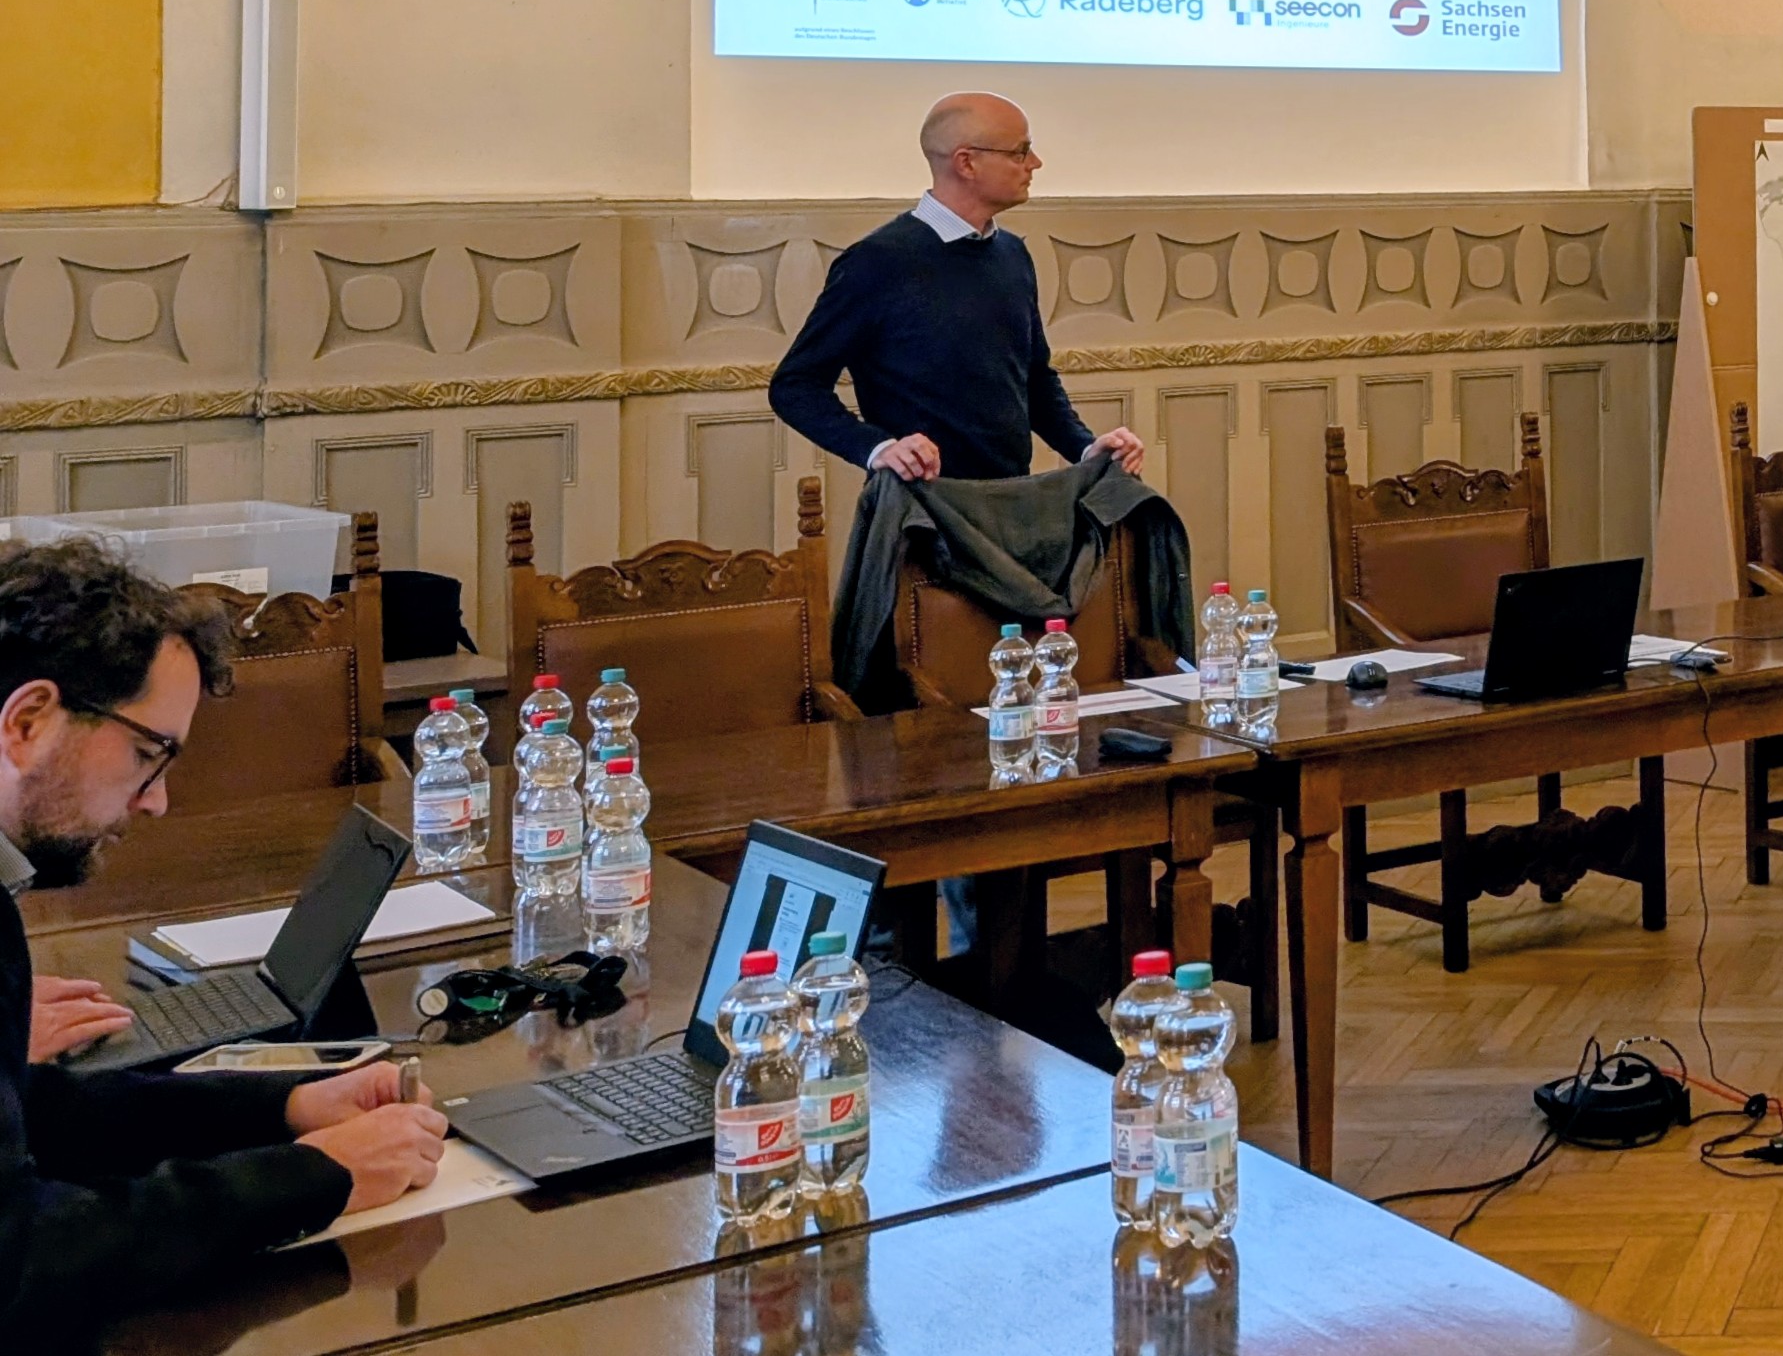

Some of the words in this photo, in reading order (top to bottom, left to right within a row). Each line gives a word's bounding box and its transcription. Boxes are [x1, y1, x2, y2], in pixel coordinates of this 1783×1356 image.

[1274, 0, 1362, 18] seecon
[1441, 0, 1527, 19] Sachsen
[1276, 19, 1330, 30] Ingenieure
[1441, 19, 1521, 42] Energie
